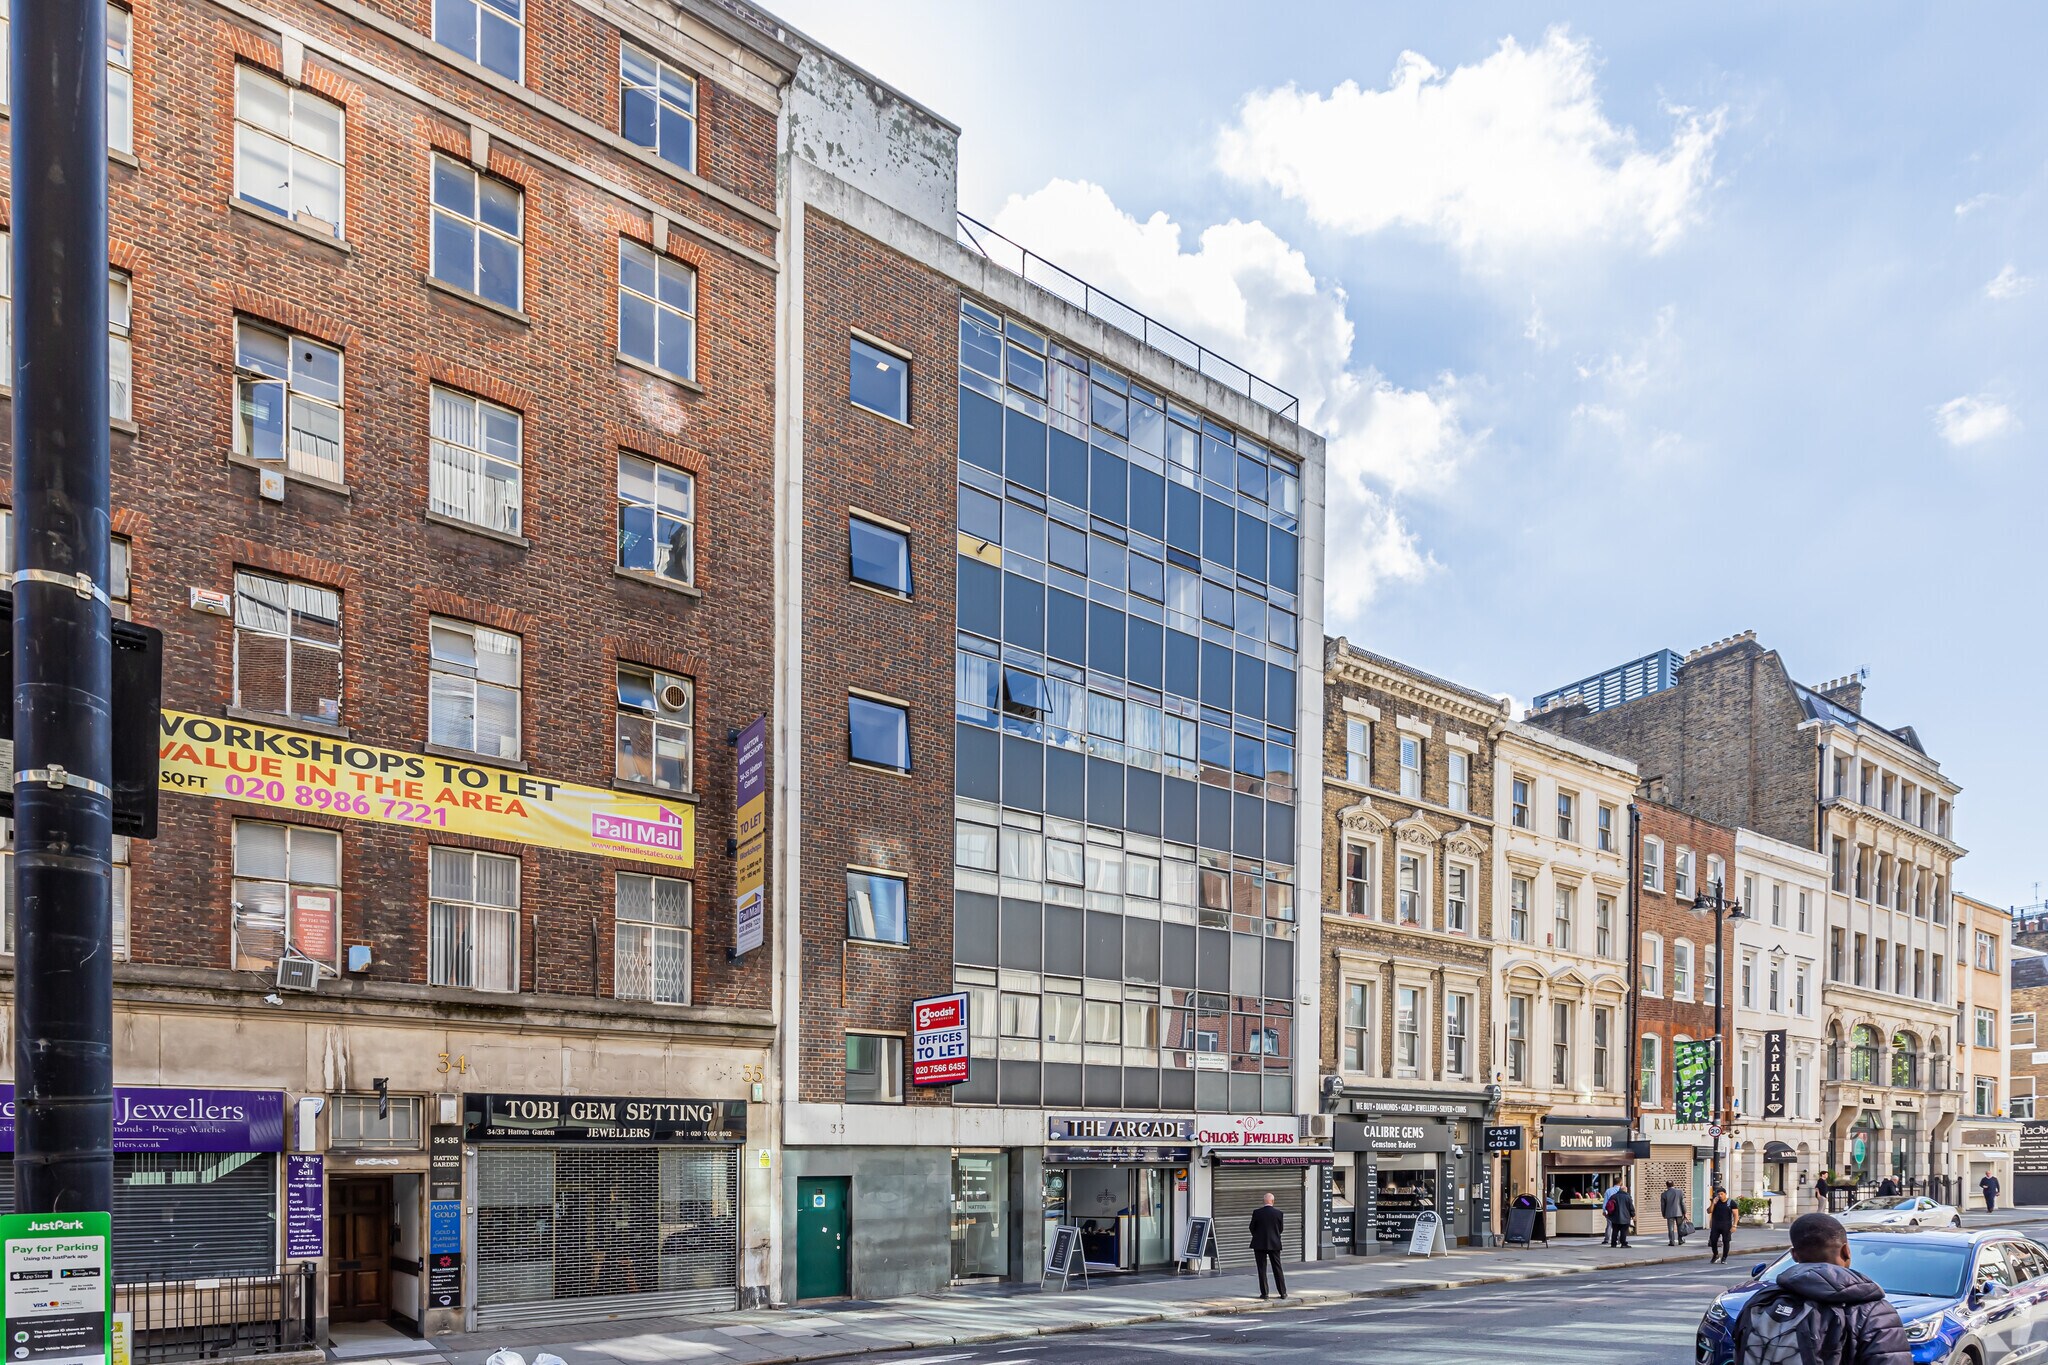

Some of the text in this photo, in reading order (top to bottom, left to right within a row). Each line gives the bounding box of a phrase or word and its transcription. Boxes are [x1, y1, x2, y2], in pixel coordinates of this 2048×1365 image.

[743, 735, 759, 753] HATTON
[739, 741, 764, 765] WORKSHOPS
[161, 771, 208, 788] SQ FT
[435, 763, 488, 788] TO
[500, 775, 560, 801] LET
[297, 763, 336, 786] IN
[349, 771, 423, 800] THE
[434, 787, 528, 818] AREA
[225, 774, 447, 827] 020 8986 7221
[595, 817, 679, 847] Pall Mall
[740, 812, 762, 836] TO LET
[591, 842, 683, 861] www.pallmallestates.co.uk
[919, 1006, 955, 1027] goodsir
[919, 1032, 962, 1046] OFFICES
[917, 1043, 964, 1060] TO LET
[437, 1053, 467, 1074] 34
[916, 1062, 966, 1074] 020 7566 6455
[1771, 1034, 1780, 1102] RAPHAEL
[743, 1064, 764, 1083] 35
[1683, 1047, 1692, 1117] JOHNSON
[1695, 1046, 1704, 1118] GARDENS
[117, 1097, 244, 1125] Jewellers
[505, 1100, 713, 1122] TOBI GEM SETTING
[1356, 1102, 1467, 1113] WE BUY DIAMONDS GOLD JEWELLERY SILVER COINS
[152, 1125, 187, 1134] Prestige
[190, 1125, 226, 1133] Watches
[586, 1127, 650, 1139] JEWELLERS
[830, 1123, 845, 1134] 33
[1070, 1120, 1185, 1137] THE ARCADE
[1363, 1125, 1424, 1139] CALIBRE GEMS
[1199, 1130, 1294, 1146] CHLOE'S JEWELLERS
[1371, 1140, 1417, 1149] Gemstone Traders
[1560, 1135, 1613, 1148] BUYING HUB
[1256, 1157, 1279, 1165] CHLOE'S
[1281, 1157, 1309, 1165] JEWELLERS
[27, 1220, 84, 1231] JustPark
[12, 1243, 99, 1254] Pay for Parking
